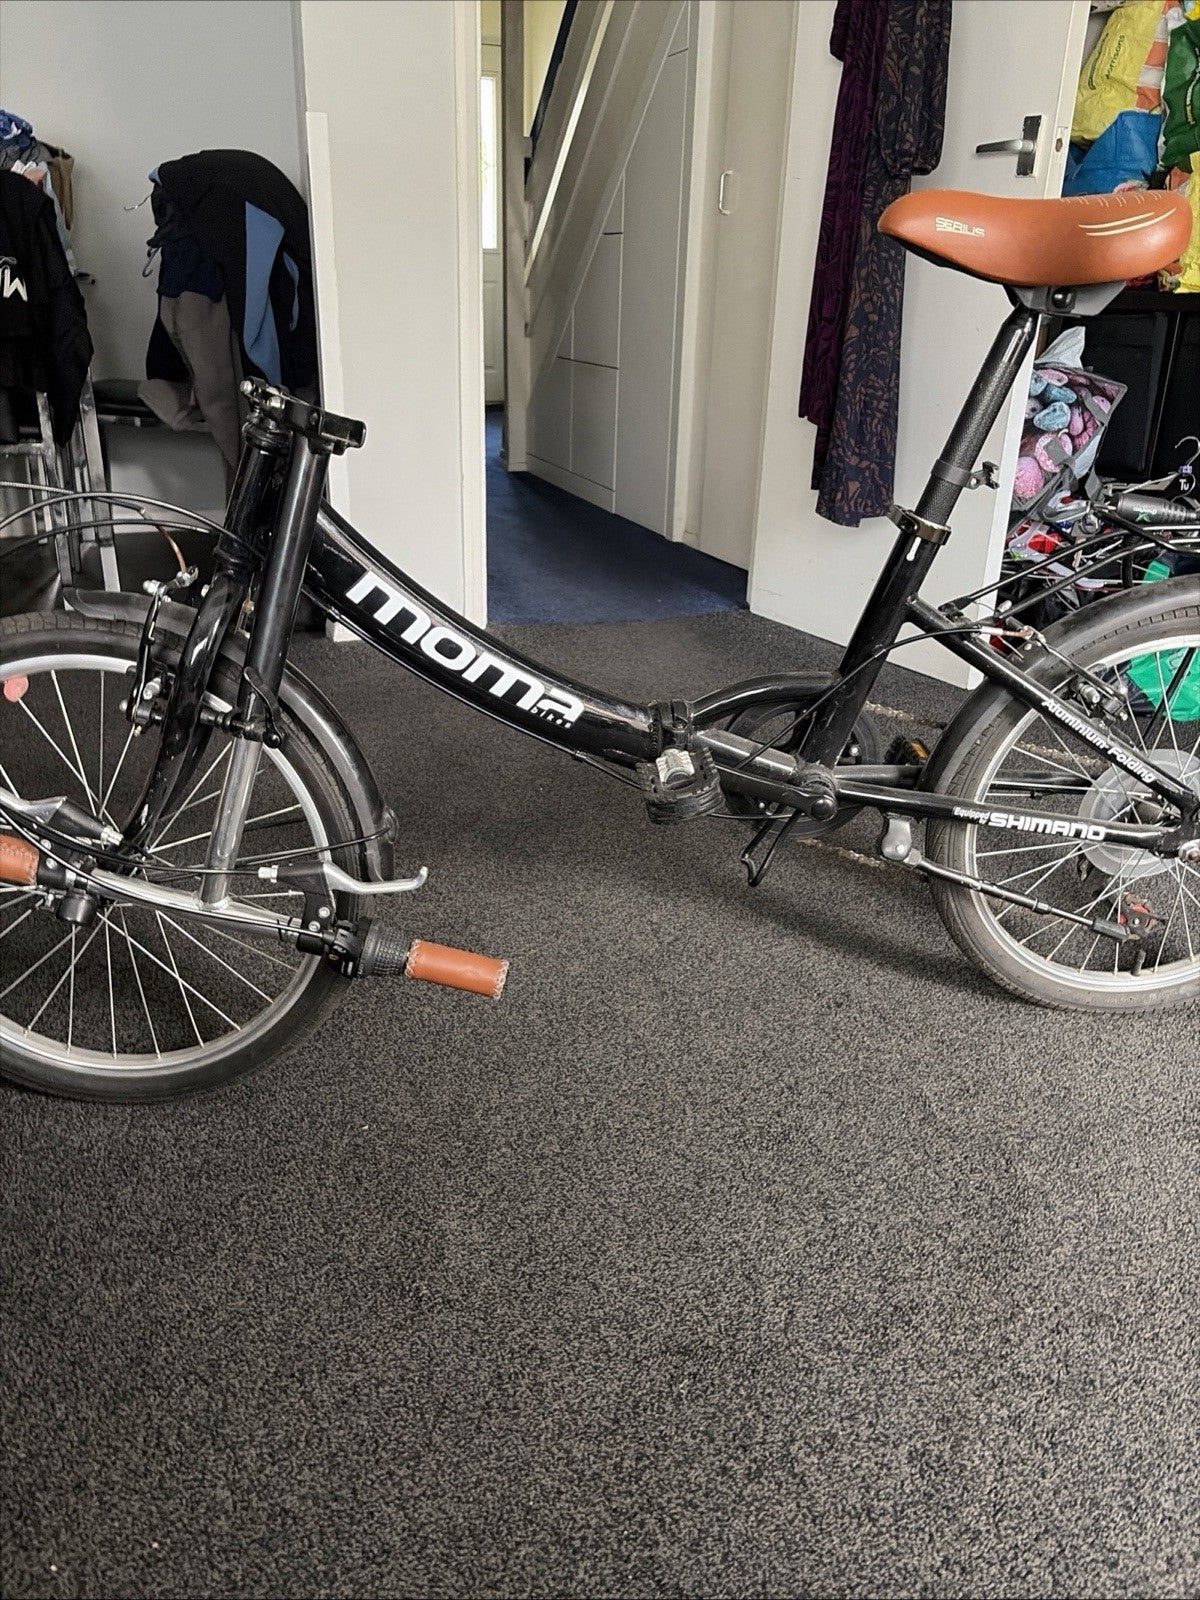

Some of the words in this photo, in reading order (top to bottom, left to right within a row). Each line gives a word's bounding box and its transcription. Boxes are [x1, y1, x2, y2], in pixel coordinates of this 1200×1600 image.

[1179, 479, 1189, 491] Tu
[345, 569, 585, 723] moma
[530, 705, 572, 729] bikes
[1107, 746, 1157, 783] Folding
[954, 806, 990, 820] Equipped
[988, 812, 1107, 841] SHIMANO
